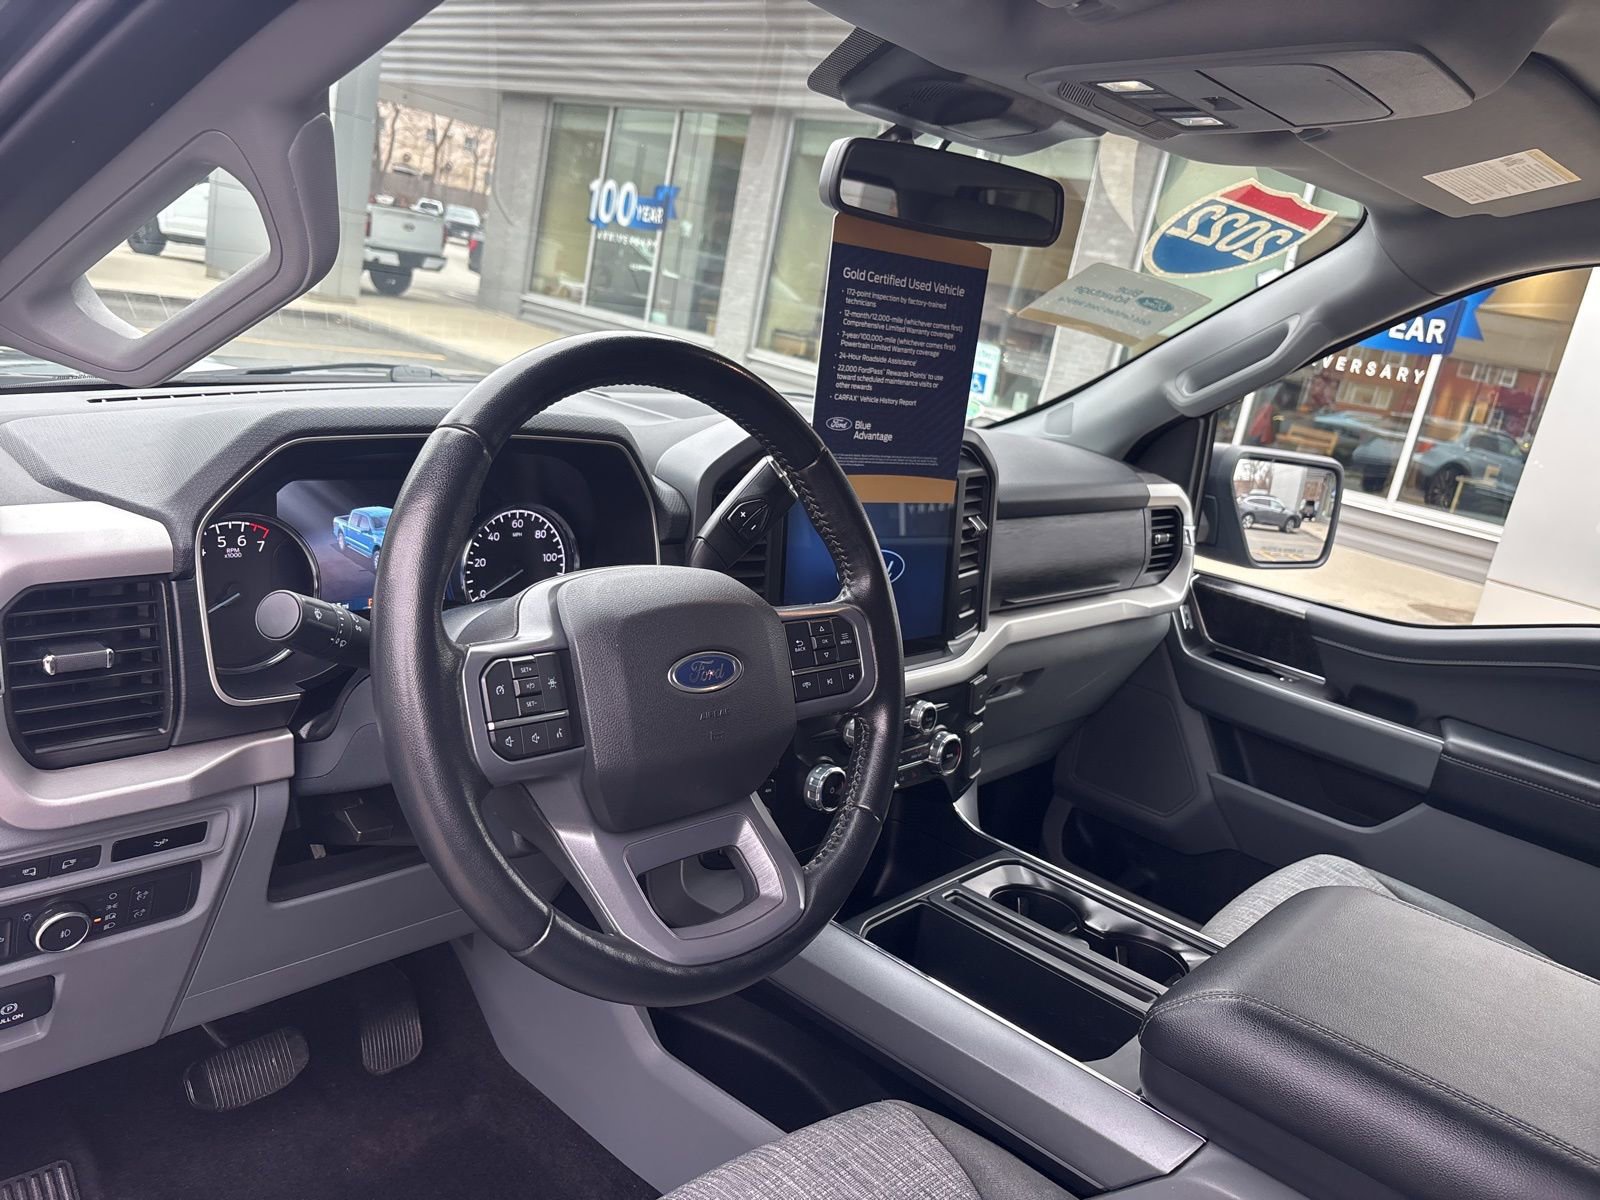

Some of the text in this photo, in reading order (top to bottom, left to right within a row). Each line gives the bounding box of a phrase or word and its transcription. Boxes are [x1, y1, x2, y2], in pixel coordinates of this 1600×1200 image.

[589, 179, 638, 227] 100
[843, 267, 965, 297] Gold Certified Used Vehicle
[886, 323, 905, 333] Limited
[930, 331, 954, 340] coverage
[871, 342, 891, 352] Limited
[916, 349, 939, 359] coverage
[839, 351, 861, 361] 24-Hour
[862, 354, 887, 364] Roadside
[886, 368, 909, 378] Rewards
[836, 373, 856, 382] toward
[857, 375, 884, 384] scheduled
[885, 378, 918, 387] maintenance
[919, 380, 932, 388] visits
[851, 383, 872, 391] rewards
[861, 395, 879, 404] Vehicle
[880, 397, 898, 407] History
[854, 420, 872, 430] Blue
[853, 430, 893, 443] Advantage
[512, 519, 524, 528] 60
[487, 530, 547, 541] 40 80
[217, 534, 265, 553] 5 6 7
[474, 552, 558, 568] 20 100
[688, 659, 725, 683] Ford
[12, 1012, 24, 1021] ON
